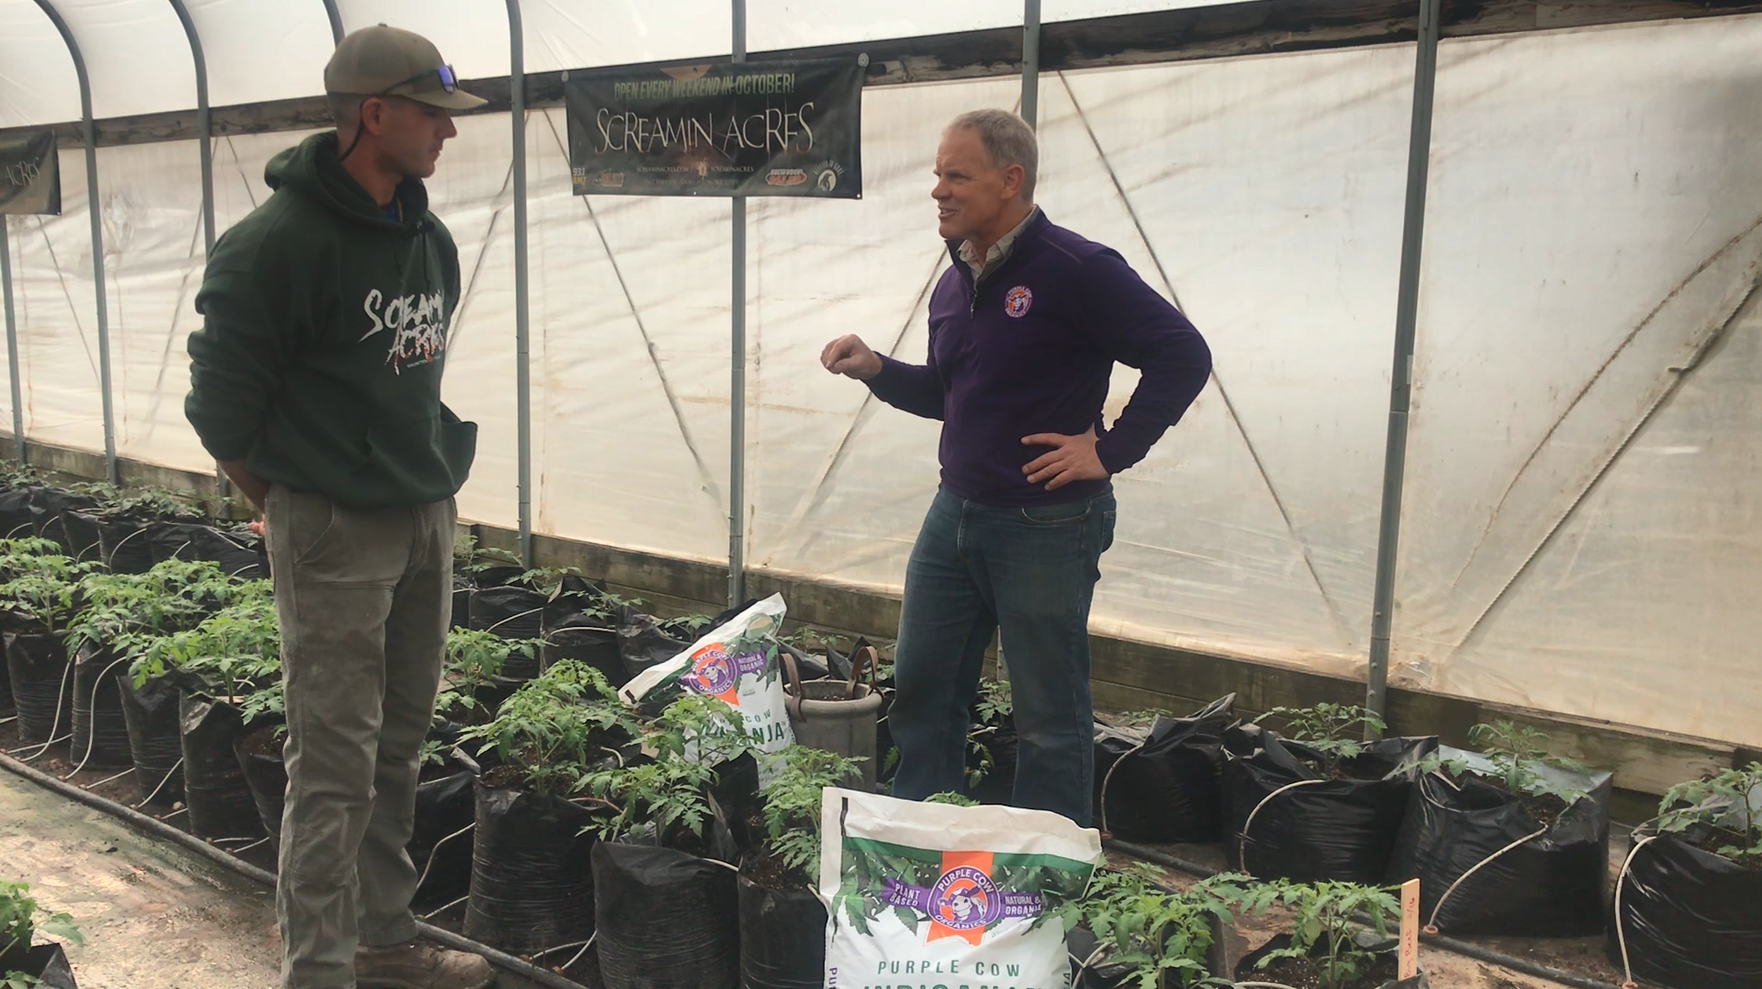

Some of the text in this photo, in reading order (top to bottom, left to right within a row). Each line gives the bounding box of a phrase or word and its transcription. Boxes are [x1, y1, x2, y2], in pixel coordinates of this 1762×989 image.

[614, 73, 795, 100] OPEN EVERY WEEKEND IN OCTOBER!
[595, 102, 815, 155] SCREAMIN ACRES
[698, 679, 733, 694] ORGANICS
[744, 708, 771, 724] COW
[938, 868, 994, 893] PURPLE COW
[889, 892, 918, 907] BASED
[895, 883, 920, 900] PLANT
[1004, 895, 1043, 906] NATURAL &
[935, 914, 987, 929] ORGANICS
[877, 959, 1021, 977] PURPLE COW
